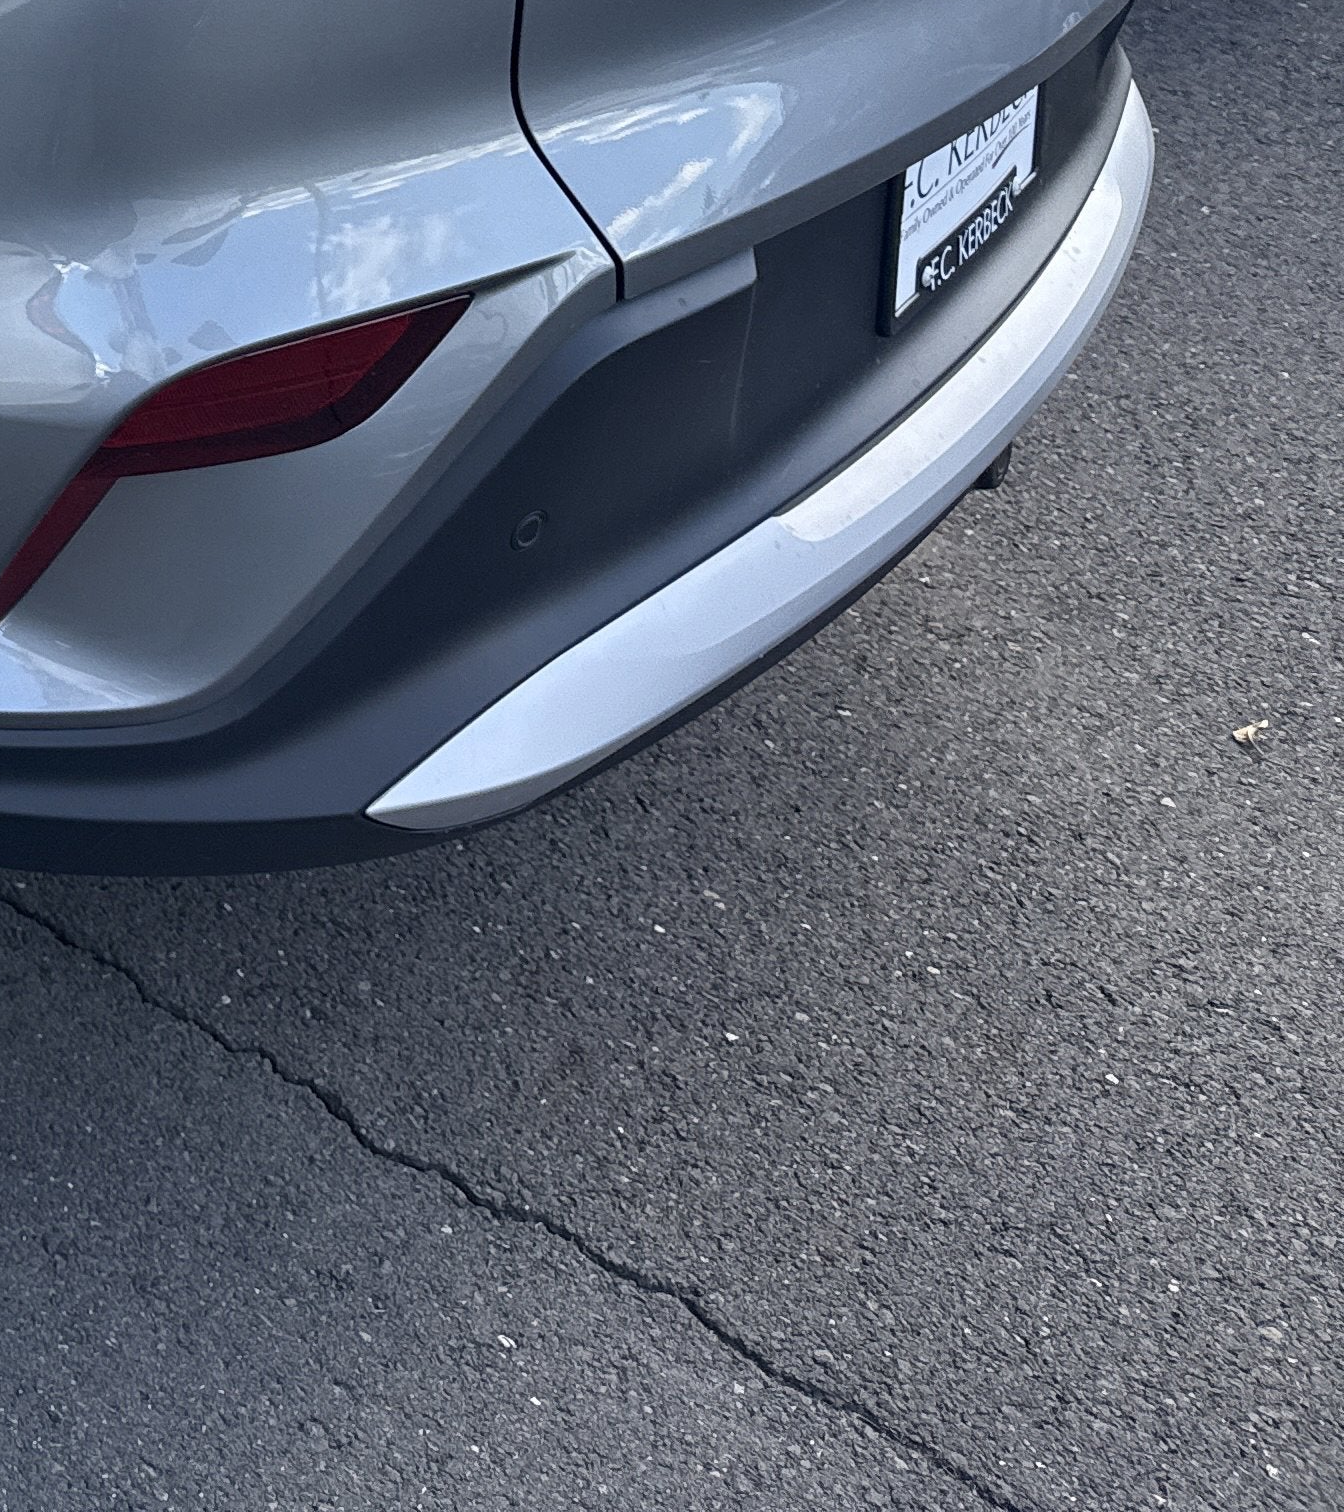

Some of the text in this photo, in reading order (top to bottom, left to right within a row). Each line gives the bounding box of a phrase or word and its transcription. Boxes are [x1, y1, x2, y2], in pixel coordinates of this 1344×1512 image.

[922, 190, 947, 224] Owned
[955, 156, 985, 196] Operated
[929, 181, 1014, 291] F.C. KERBECK
